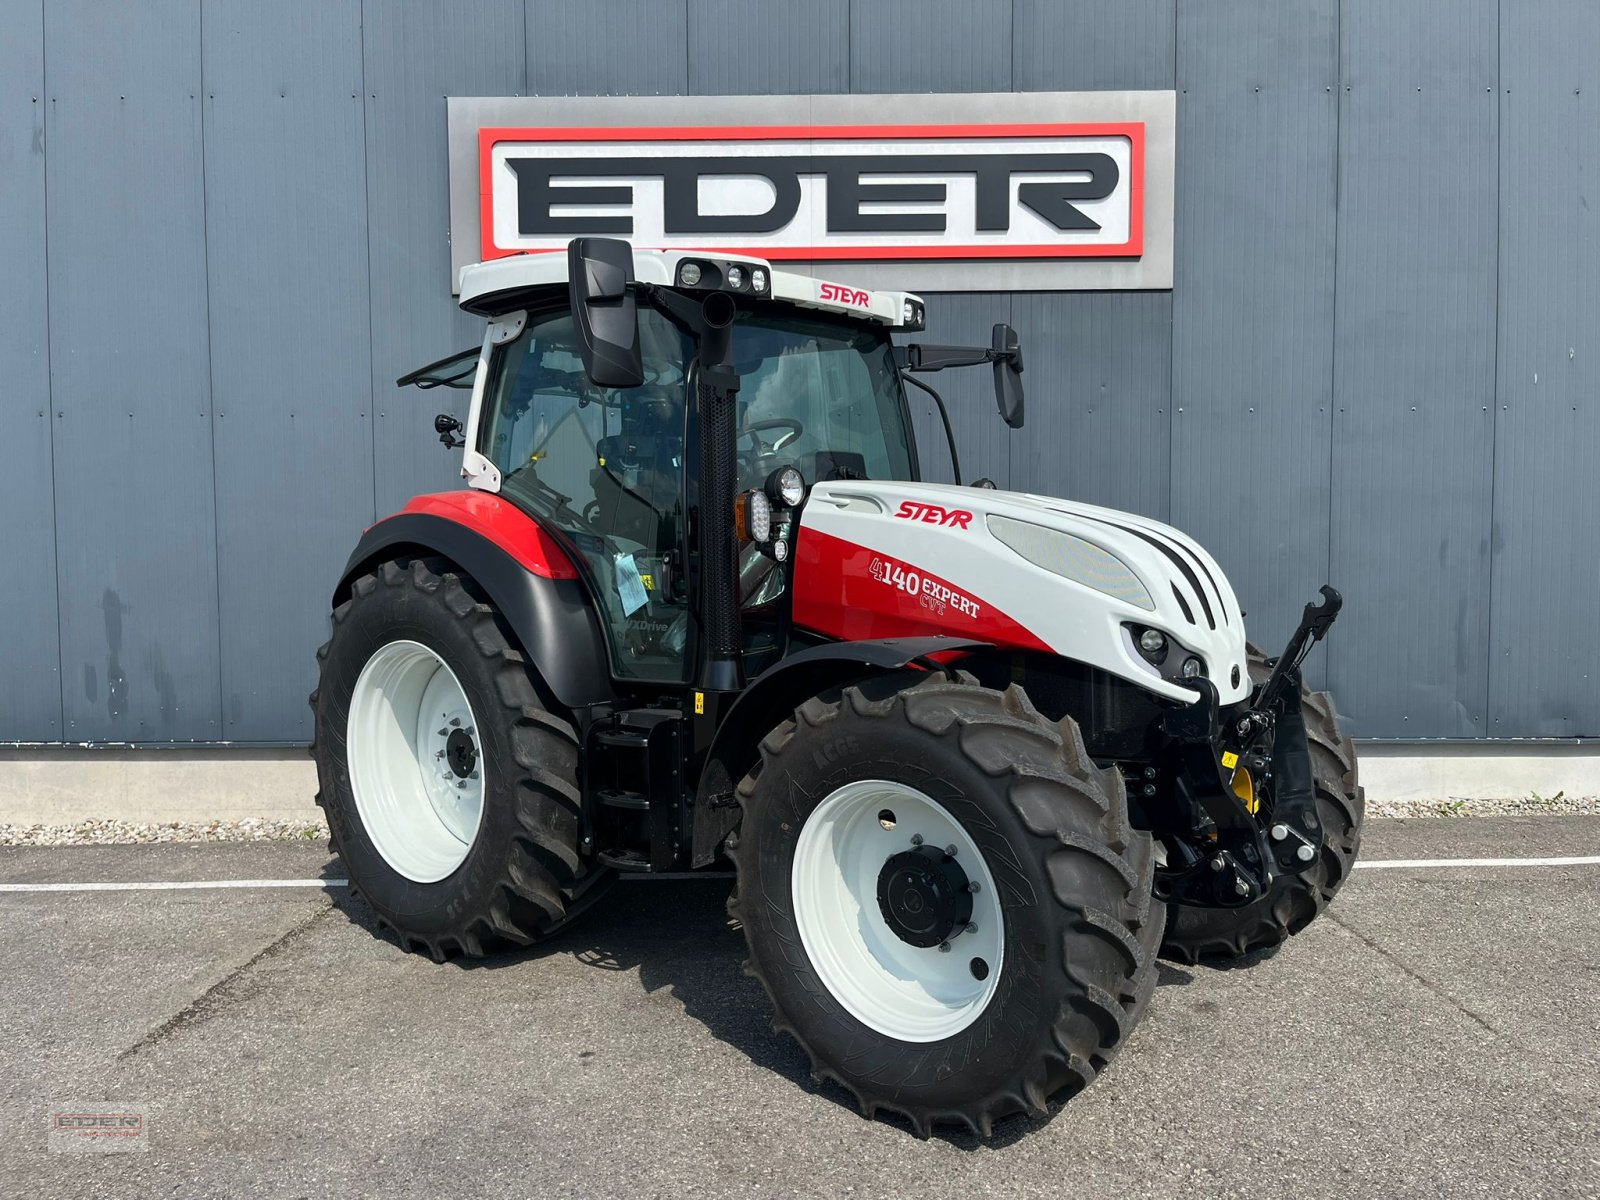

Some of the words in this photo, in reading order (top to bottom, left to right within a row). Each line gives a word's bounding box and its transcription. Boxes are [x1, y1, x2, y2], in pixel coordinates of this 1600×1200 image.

[504, 152, 1120, 234] EDER
[820, 283, 869, 308] STEYR
[894, 500, 973, 531] STEYR
[868, 557, 920, 596] 4140
[922, 577, 981, 619] EXPERT
[919, 593, 947, 616] CVT
